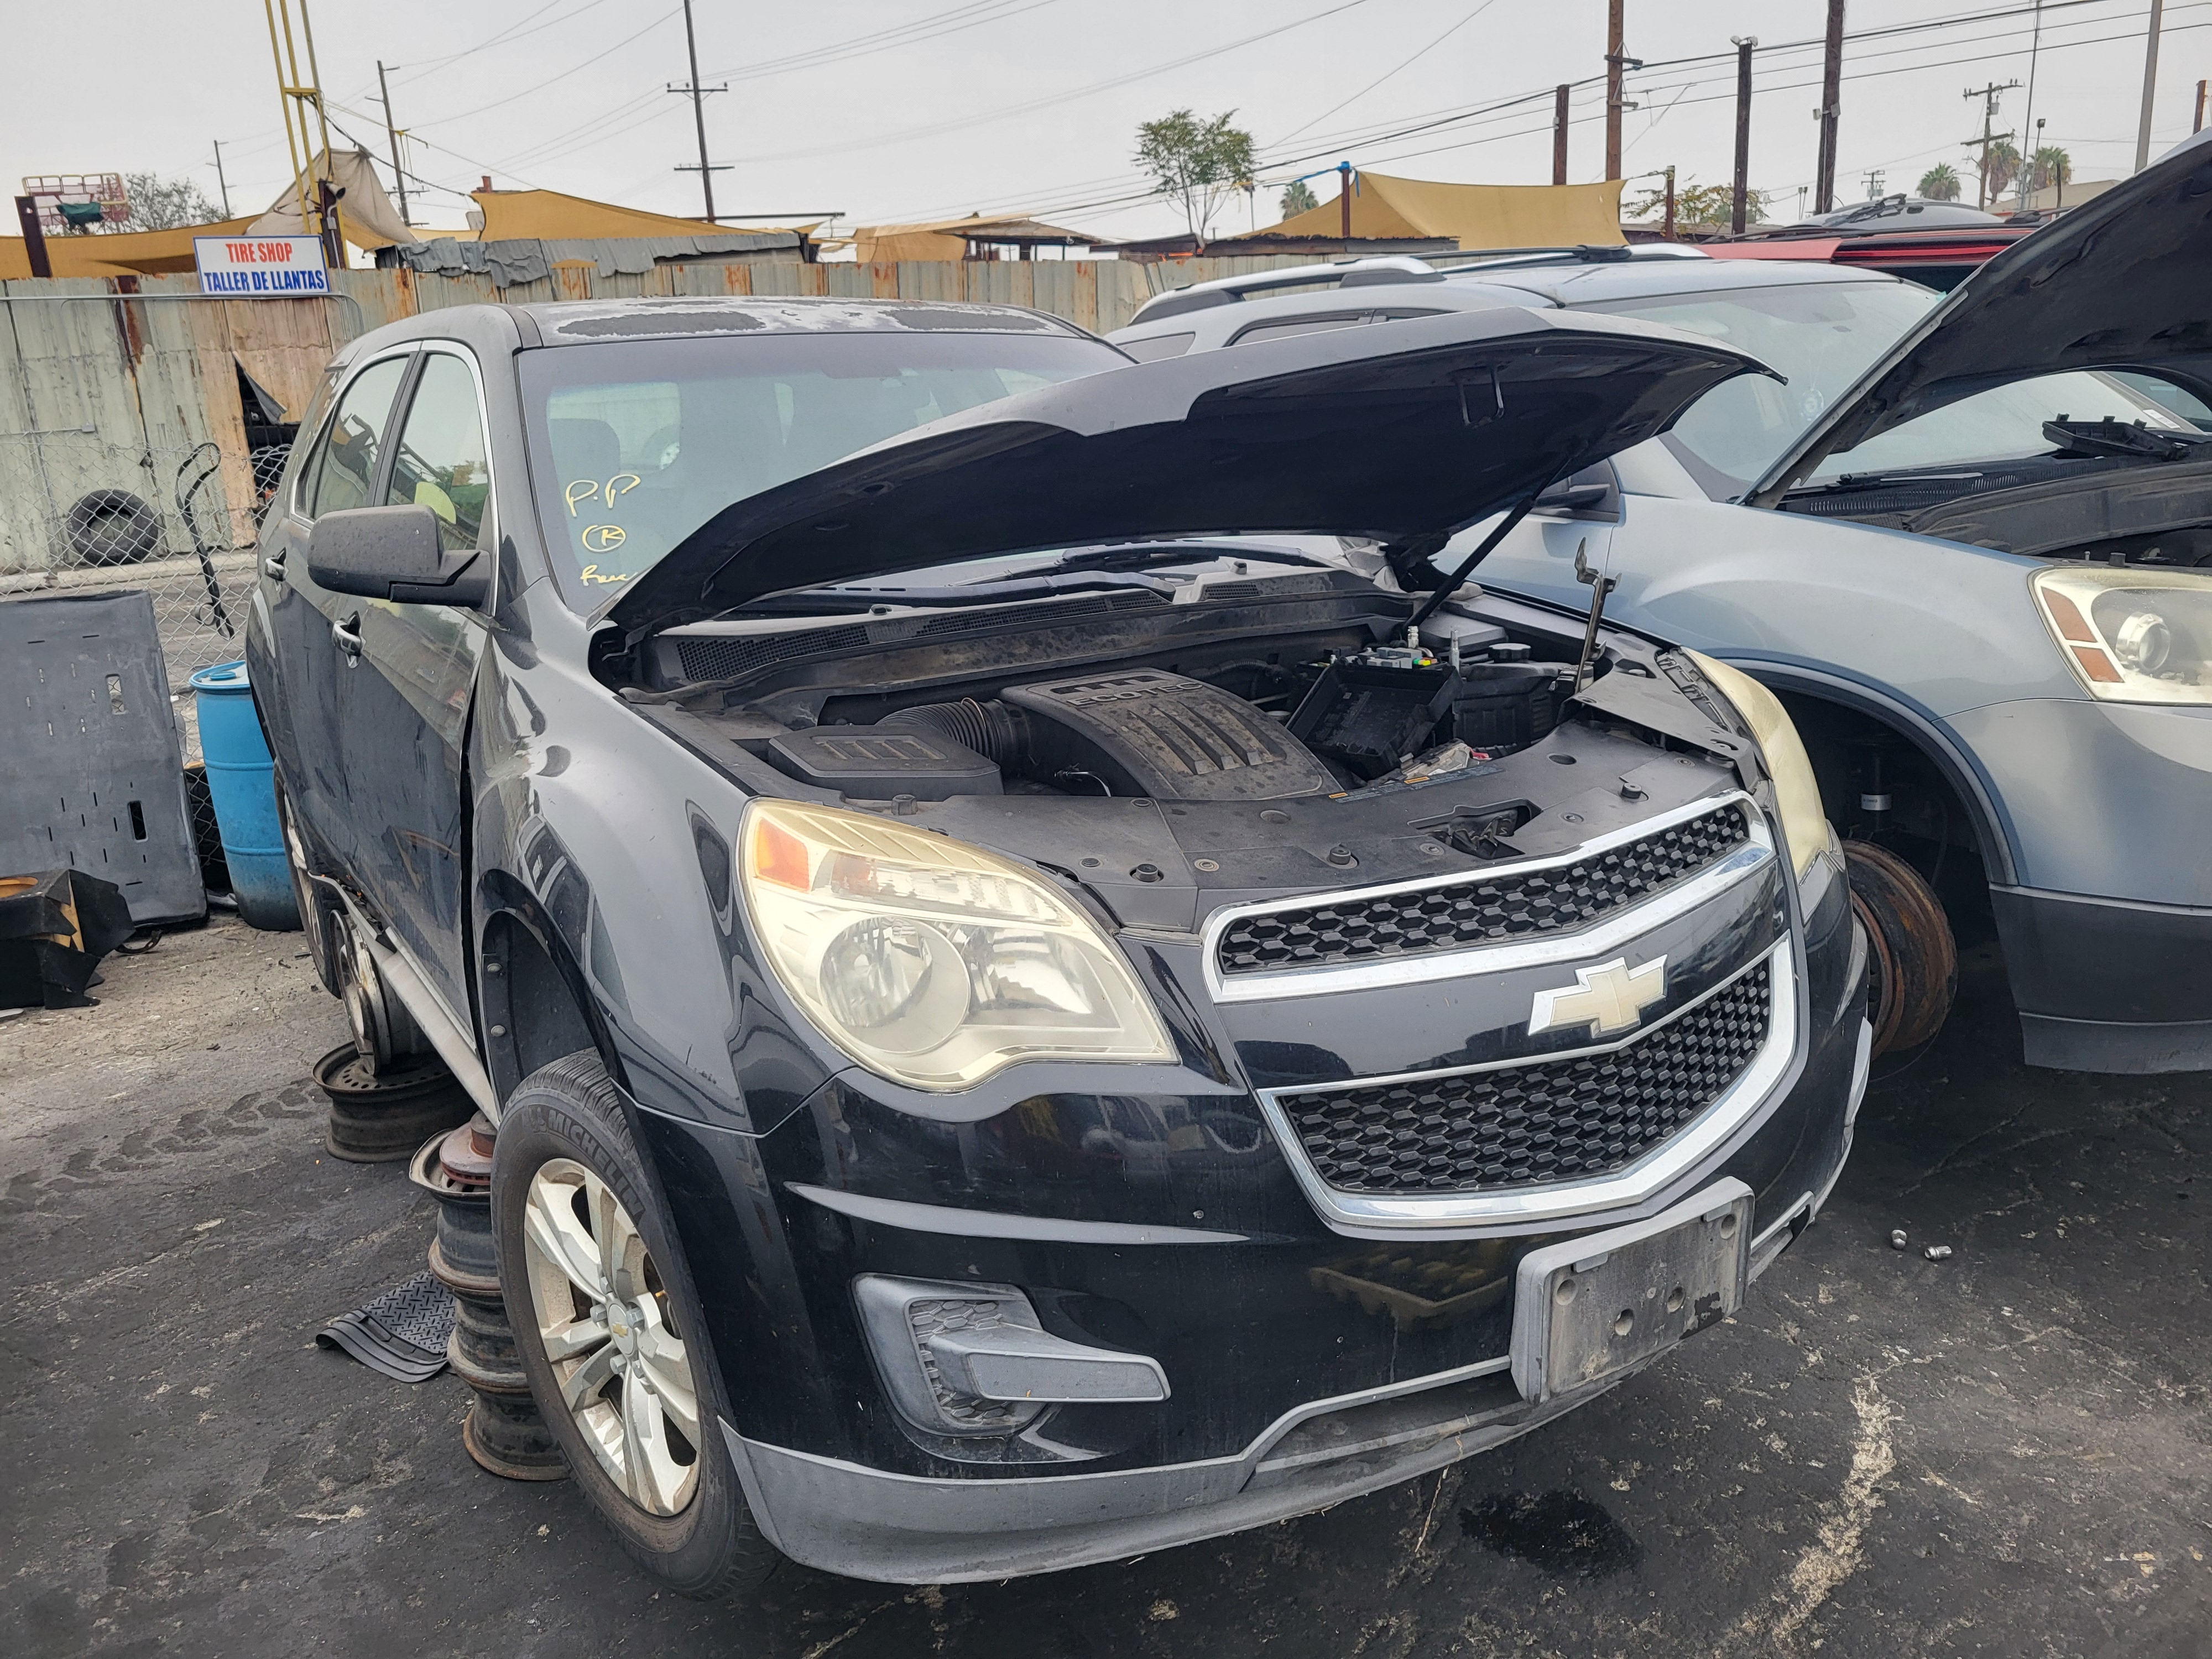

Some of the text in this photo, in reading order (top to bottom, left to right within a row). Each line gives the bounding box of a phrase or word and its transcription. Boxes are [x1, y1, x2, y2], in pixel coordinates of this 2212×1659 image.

[226, 242, 293, 263] TIRE SHOP
[204, 270, 325, 292] TALLER DE LLANTAS
[1066, 682, 1203, 706] ECOTEC
[548, 1109, 646, 1216] MICHELIN
